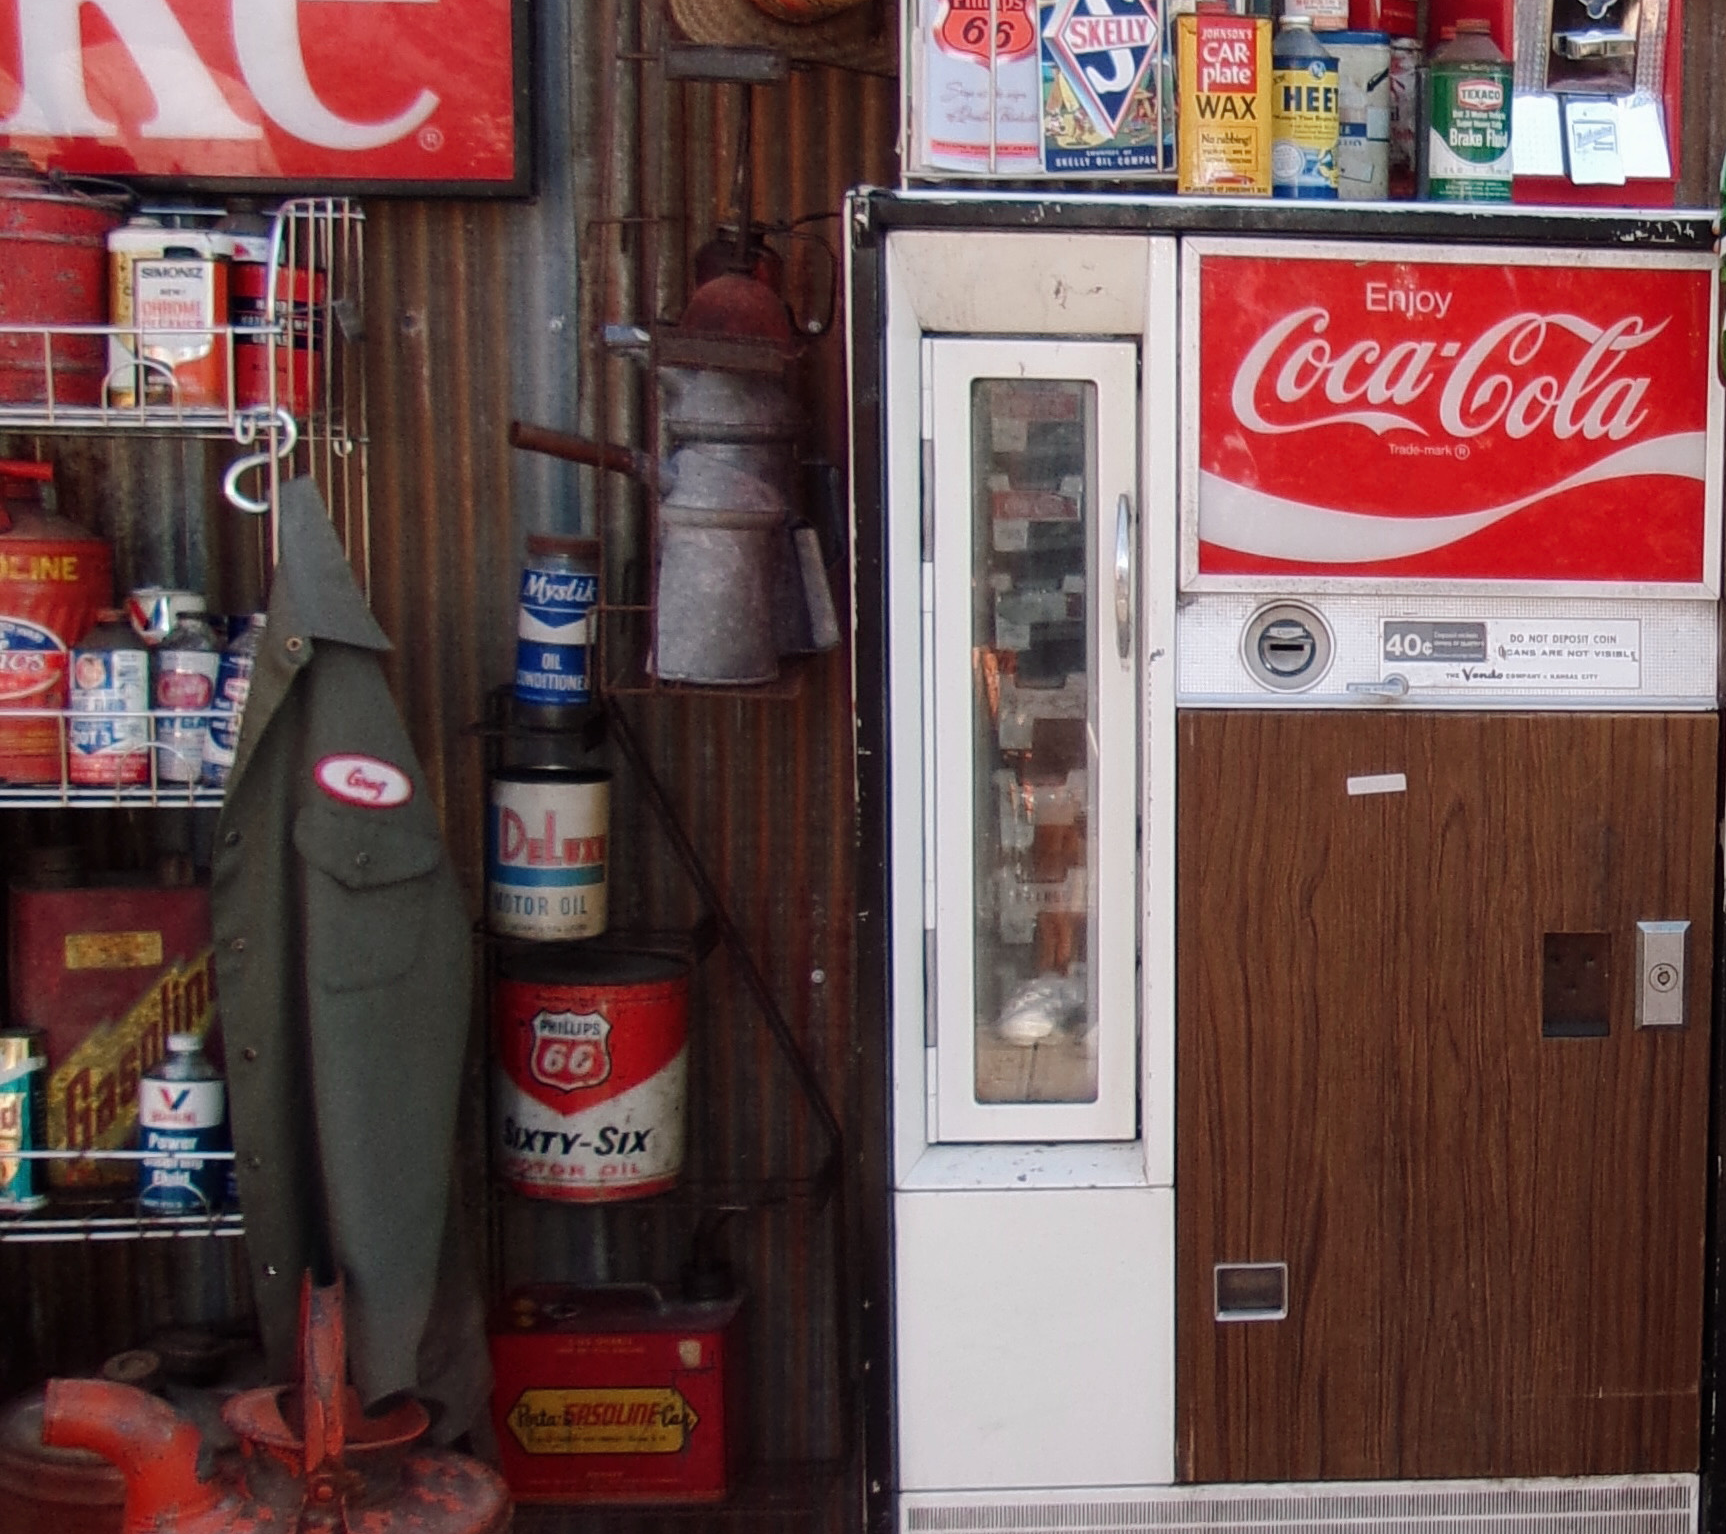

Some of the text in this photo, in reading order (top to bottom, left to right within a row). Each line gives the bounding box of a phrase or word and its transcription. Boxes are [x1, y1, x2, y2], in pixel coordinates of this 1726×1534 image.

[1069, 18, 1149, 49] SKELLY
[1202, 63, 1252, 93] plate
[1461, 88, 1502, 100] TEXACO
[1195, 94, 1257, 121] WAX
[1449, 127, 1509, 148] Brake Fluid
[140, 266, 203, 279] SIMONIZ
[1365, 281, 1453, 319] Enjoy
[1230, 306, 1673, 440] Coca-Cola
[1388, 442, 1453, 456] Trade-mark
[1385, 632, 1434, 657] 40¢
[1509, 633, 1618, 645] DO NOT DEPOSIT COIN
[541, 652, 563, 670] OIL
[1541, 648, 1563, 658] ARE
[1567, 649, 1589, 659] NOT
[1461, 668, 1504, 681] Vendo
[1505, 672, 1541, 680] COMPANY
[1550, 673, 1579, 681] KANSAS
[560, 894, 588, 915] OIL
[539, 1019, 601, 1036] PHILLIPS
[600, 1163, 641, 1177] OIL
